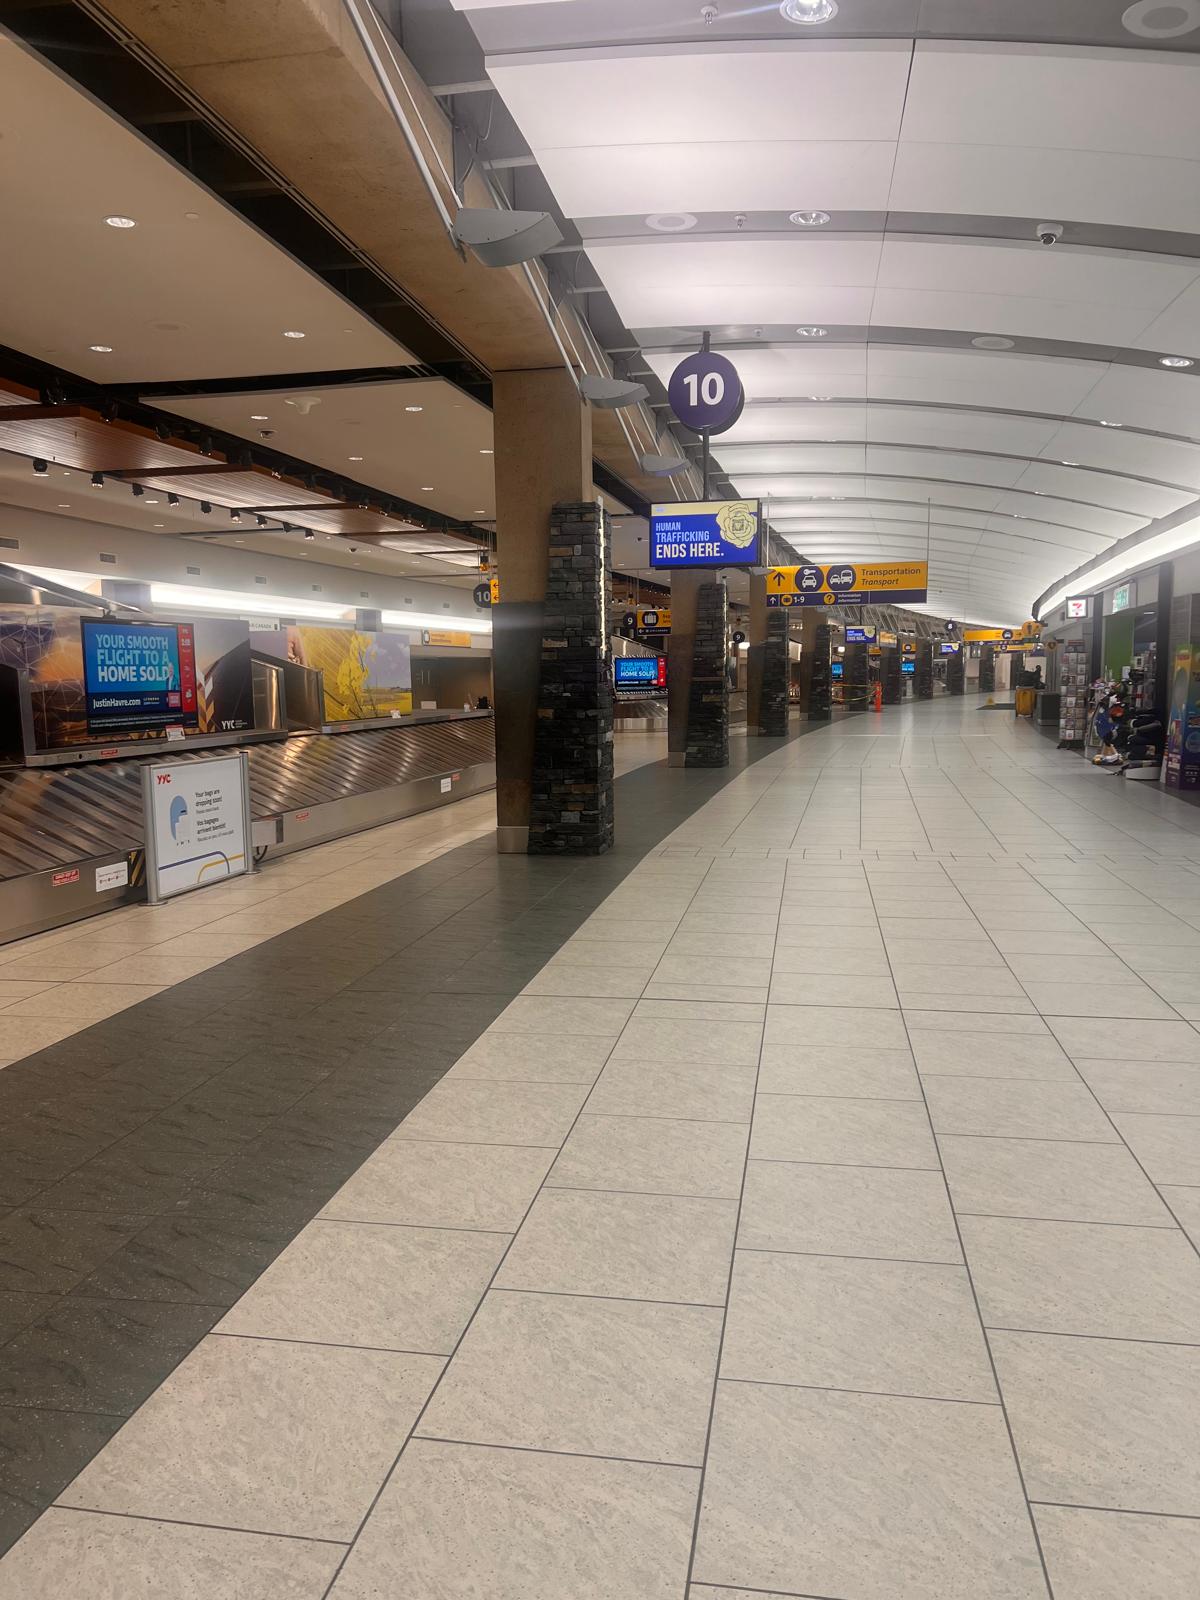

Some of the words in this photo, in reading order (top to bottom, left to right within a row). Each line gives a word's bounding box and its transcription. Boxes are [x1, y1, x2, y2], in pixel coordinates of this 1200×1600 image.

[683, 372, 725, 406] 10
[656, 522, 681, 531] HUMAN
[656, 531, 710, 542] TRAFFICKING
[656, 544, 687, 559] ENDS
[690, 543, 725, 557] HERE.
[861, 567, 921, 577] Transportation
[861, 578, 899, 586] Transport
[476, 591, 491, 602] 10
[96, 634, 125, 649] YOUR
[127, 635, 169, 649] SMOOTH
[97, 649, 140, 665] FLIGHT
[143, 651, 159, 665] TO
[162, 651, 169, 664] A
[98, 666, 137, 682] HOME
[93, 698, 141, 709] JustinHavre.com
[221, 720, 235, 729] YYC
[157, 774, 171, 784] YYC
